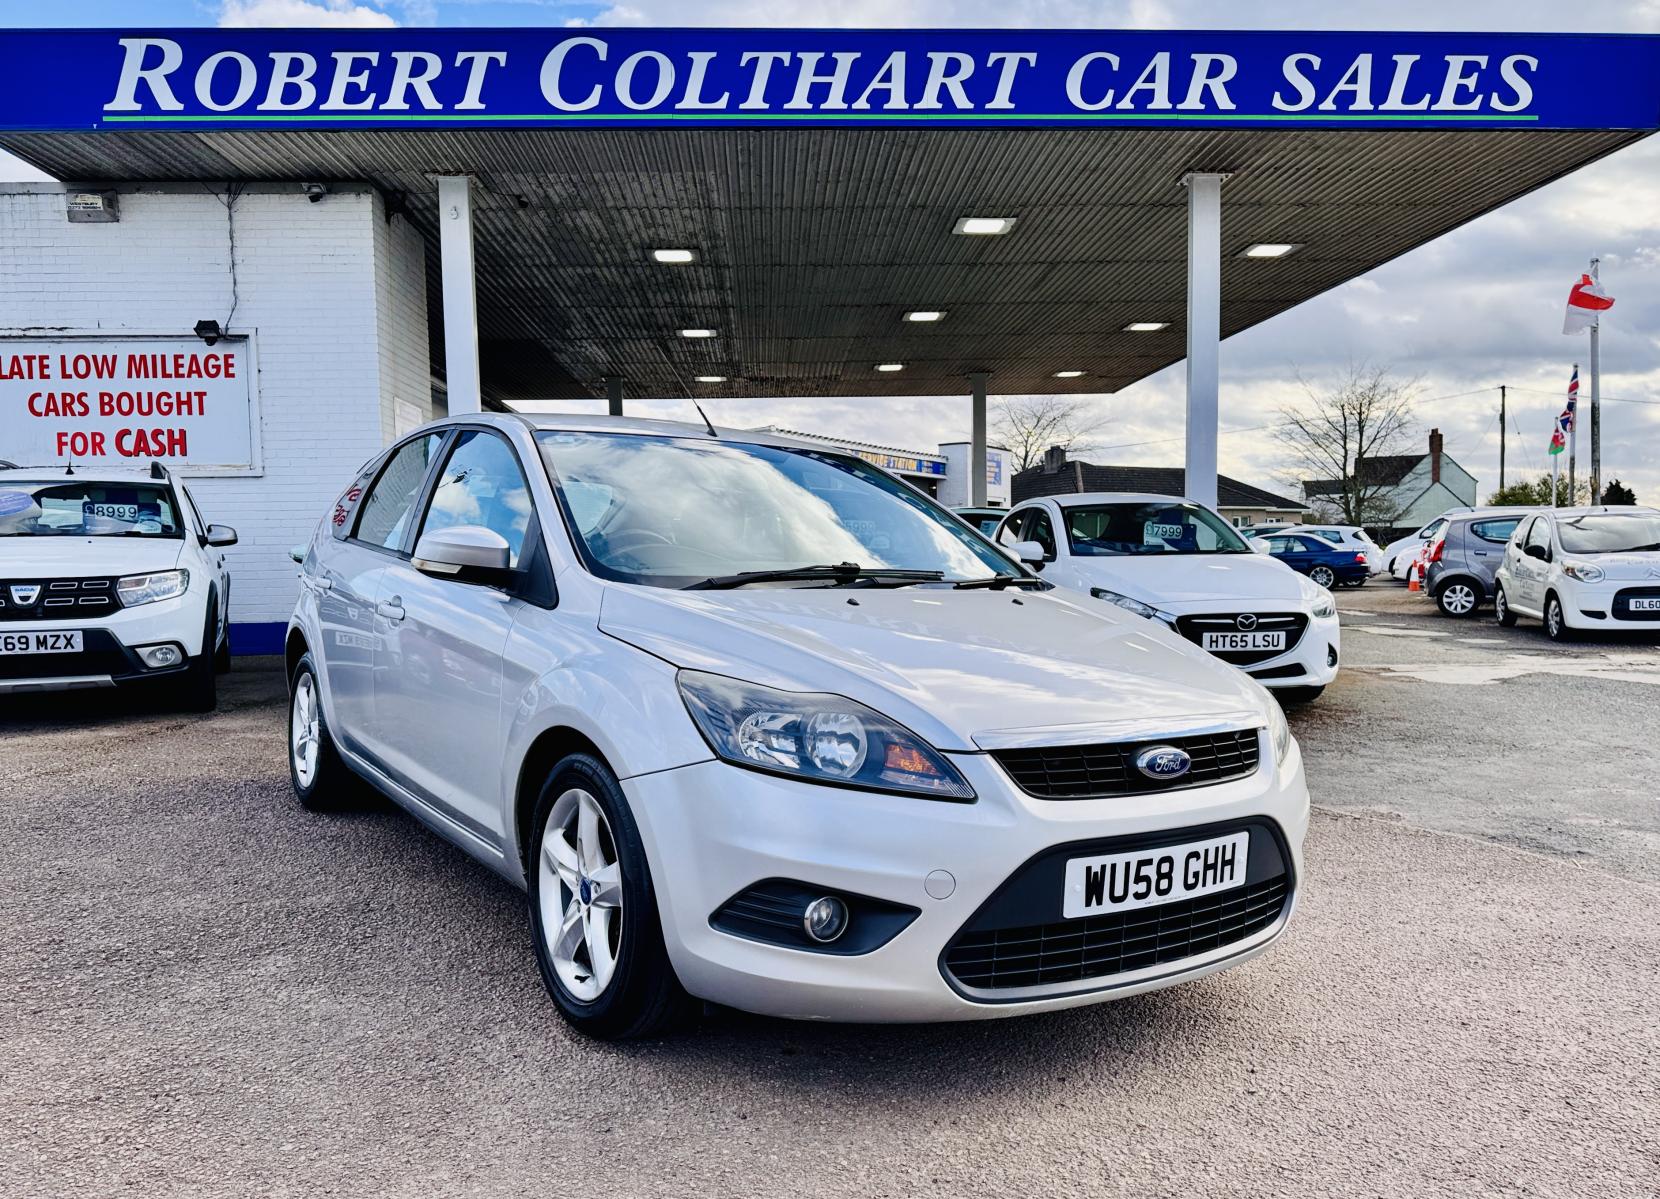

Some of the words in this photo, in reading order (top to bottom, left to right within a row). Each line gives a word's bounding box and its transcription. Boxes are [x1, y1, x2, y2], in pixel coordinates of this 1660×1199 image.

[103, 38, 507, 112] ROBERT
[539, 36, 1038, 112] COLTHART
[1065, 51, 1238, 111] CAR
[1271, 53, 1539, 112] SALES
[0, 355, 50, 380] LATE
[60, 354, 117, 380] LOW
[127, 353, 235, 379] MILEAGE
[28, 392, 90, 417] CARS
[99, 391, 207, 417] BOUGHT
[57, 431, 106, 457] FOR
[115, 428, 187, 457] CASH
[0, 635, 30, 652] 69
[35, 634, 75, 651] MZX
[1209, 634, 1249, 648] HT65
[1252, 634, 1280, 648] LSU
[1155, 753, 1181, 772] Ford
[1084, 855, 1175, 908] WU58
[1182, 842, 1237, 892] GHH
